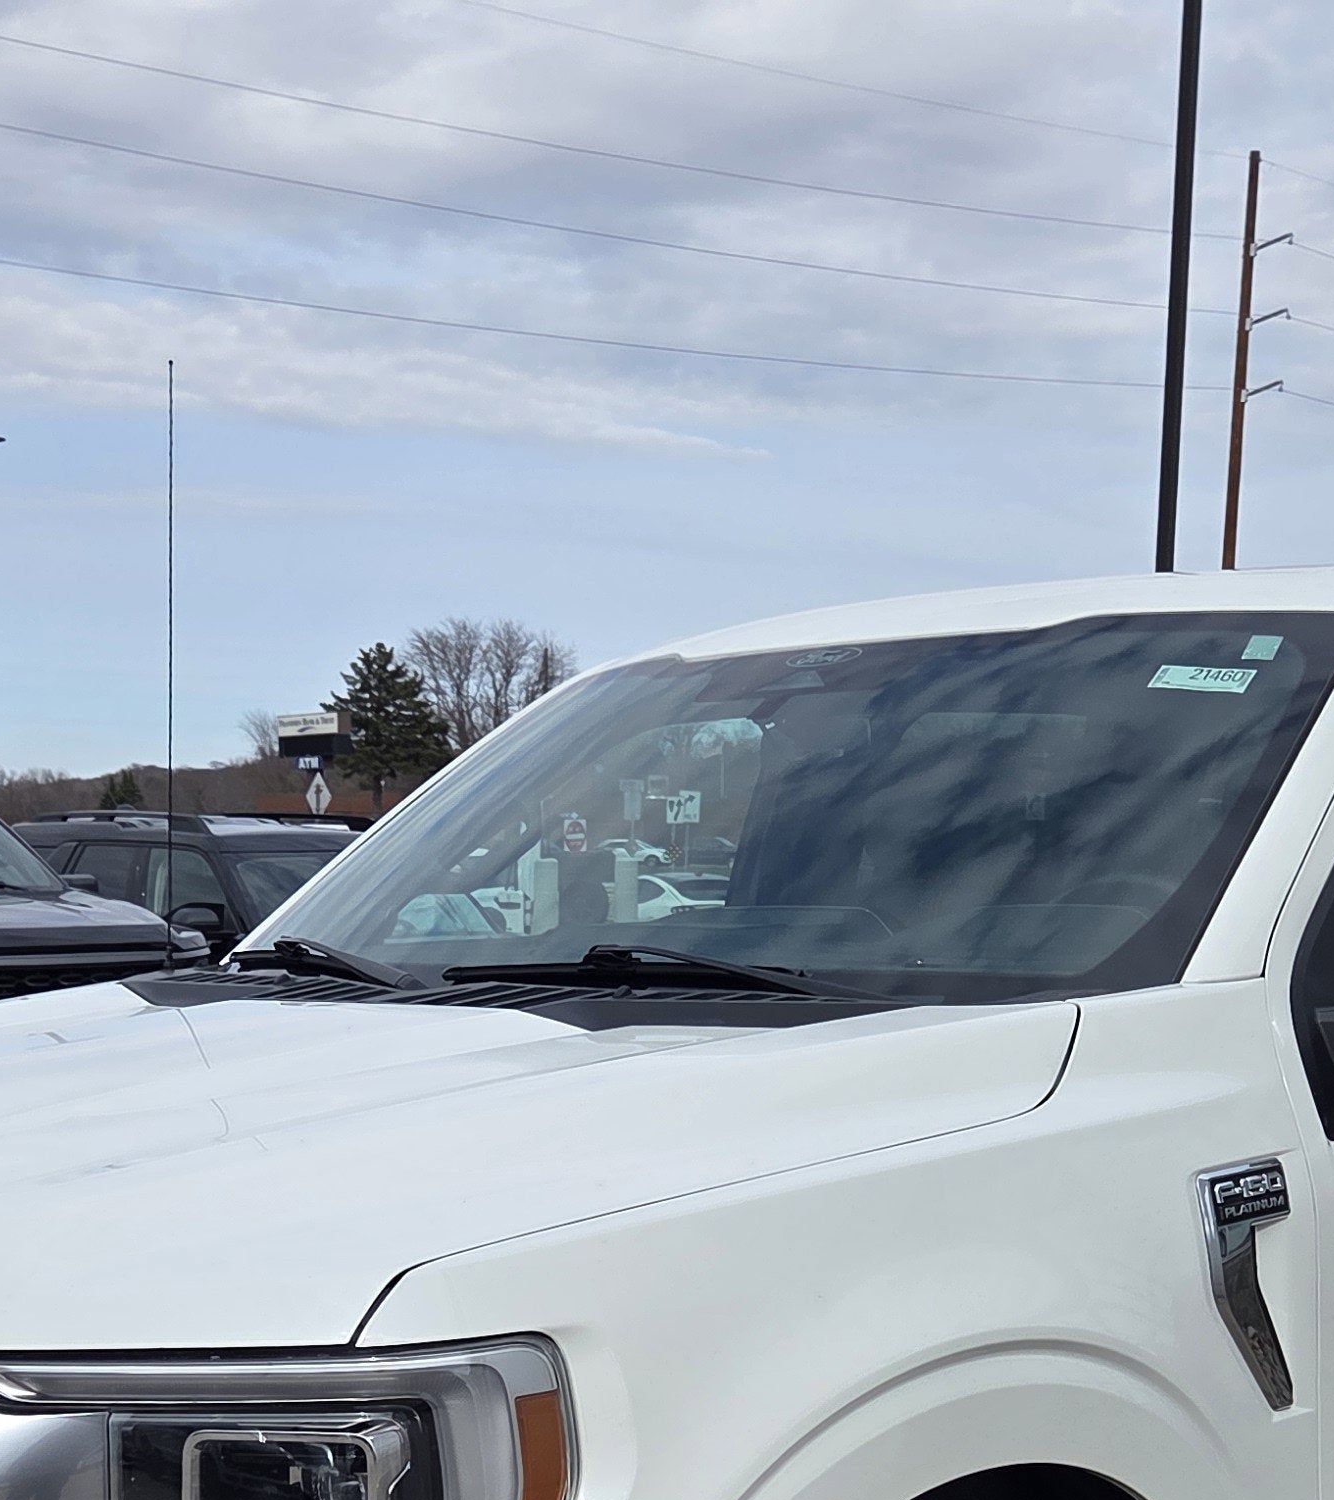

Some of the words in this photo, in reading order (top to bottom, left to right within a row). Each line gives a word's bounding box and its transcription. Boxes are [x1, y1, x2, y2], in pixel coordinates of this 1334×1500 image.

[1188, 668, 1245, 683] 21460
[1214, 1173, 1285, 1204] F-150
[1224, 1195, 1285, 1219] PLATINUM
